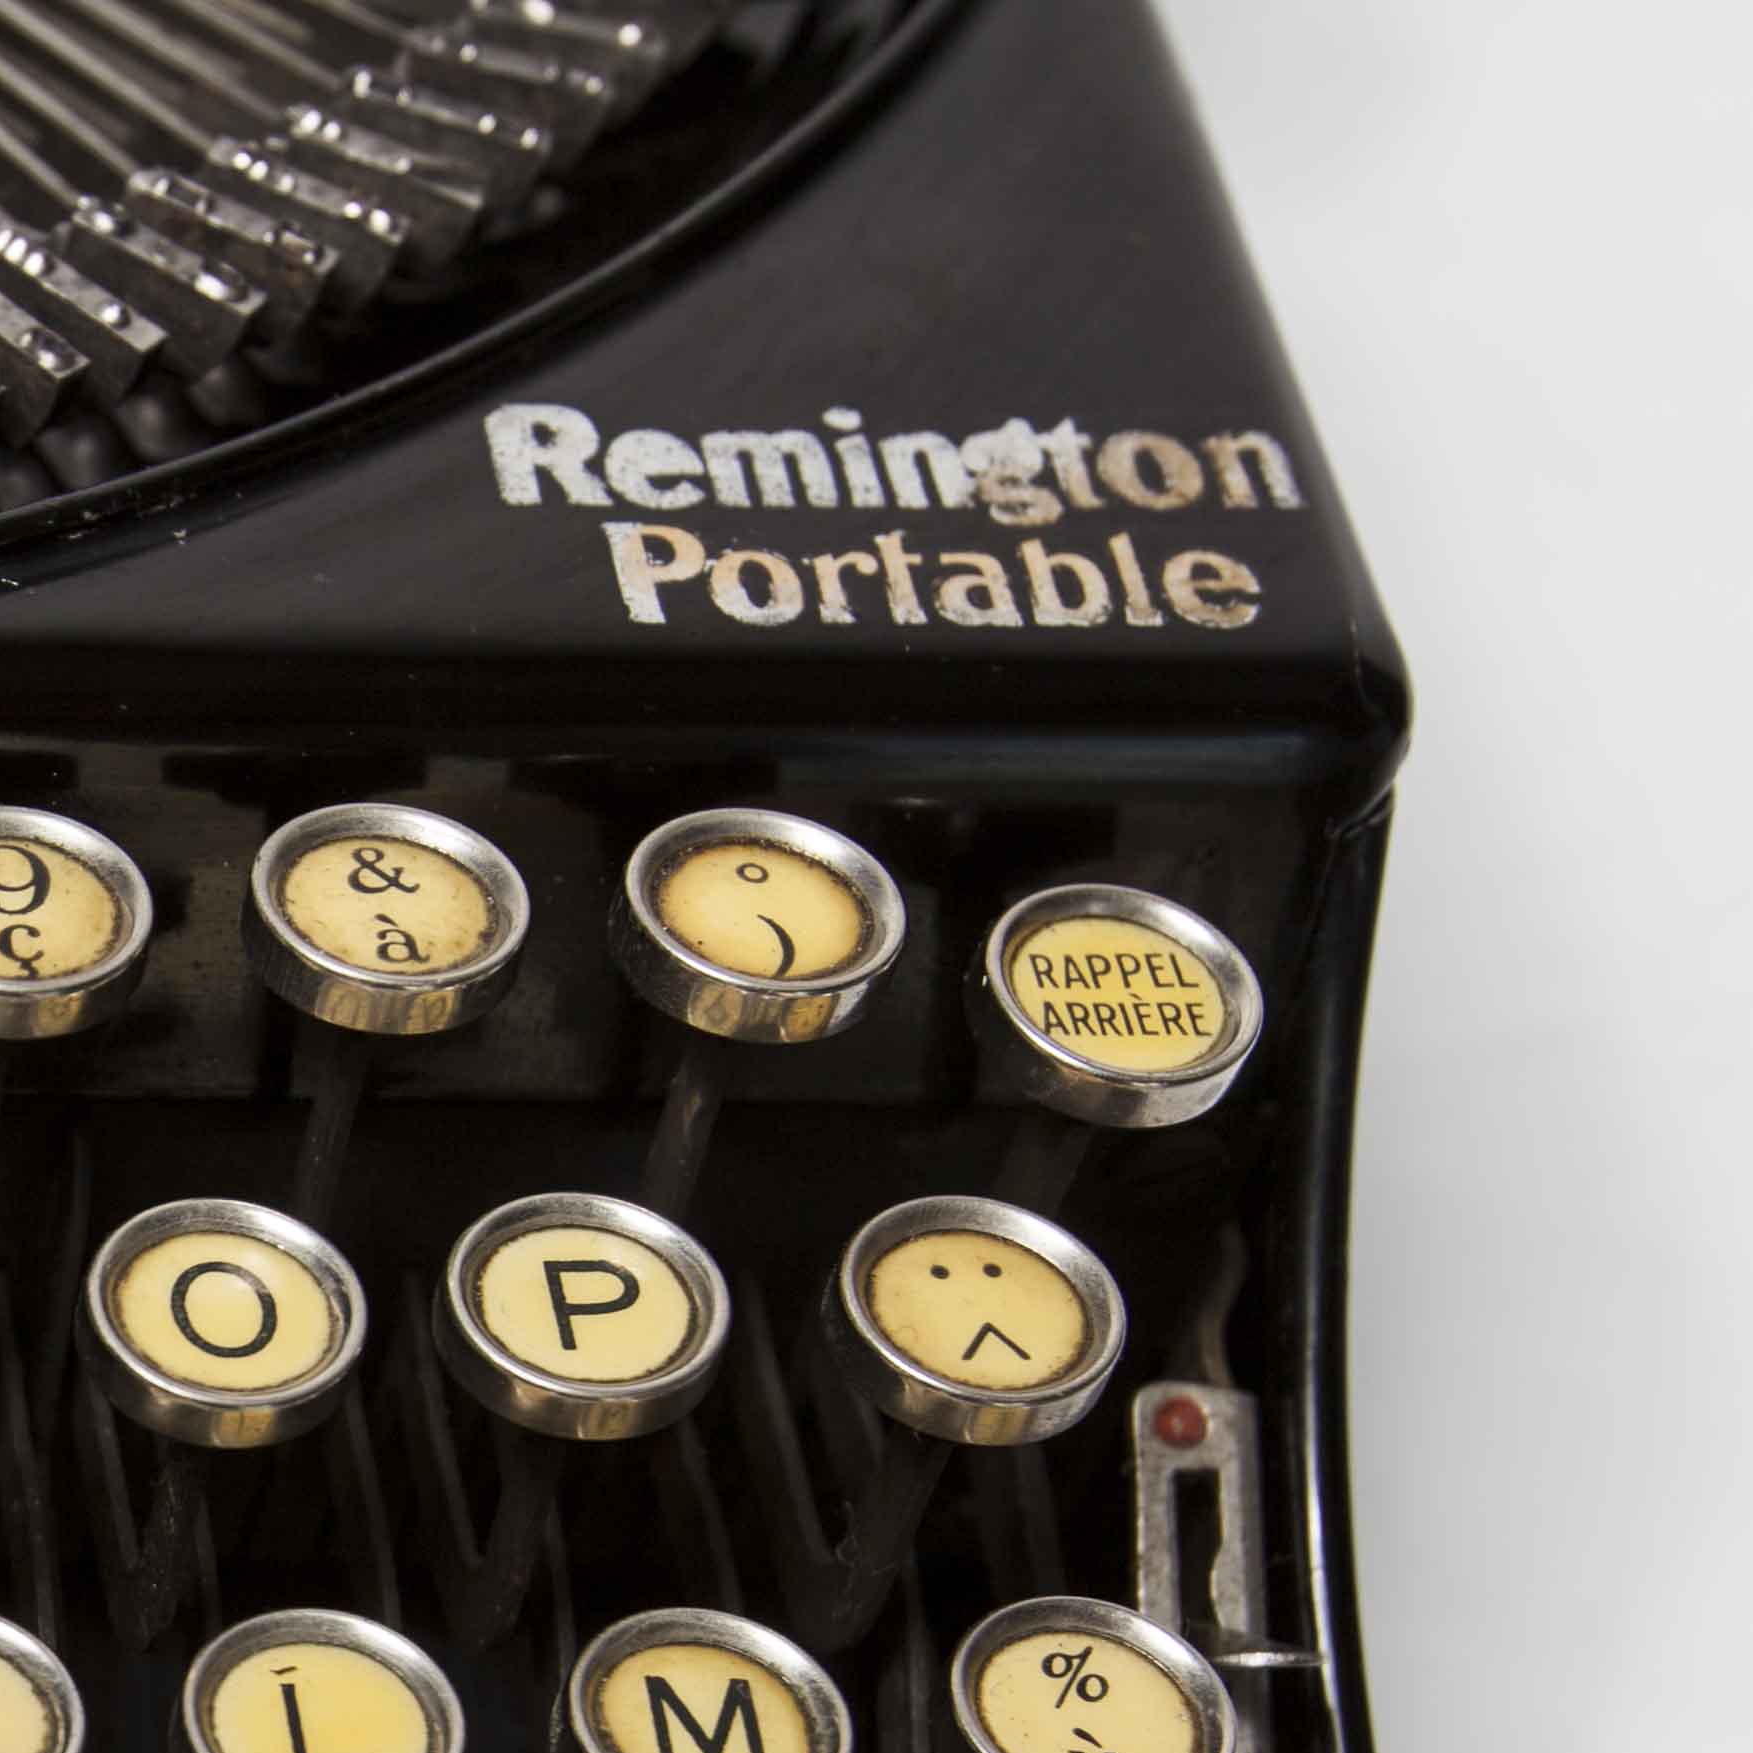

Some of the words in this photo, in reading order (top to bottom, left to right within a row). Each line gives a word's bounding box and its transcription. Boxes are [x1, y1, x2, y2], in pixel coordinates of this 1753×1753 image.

[484, 402, 1306, 527] Remington
[600, 520, 1263, 629] Portable
[347, 846, 420, 895] &
[375, 913, 431, 965] à
[756, 913, 796, 978] )
[1027, 952, 1200, 990] RAPPEL
[1042, 992, 1213, 1037] ARRIÈRE
[169, 1260, 279, 1360] O
[542, 1258, 641, 1352] P
[1040, 1645, 1110, 1710] %
